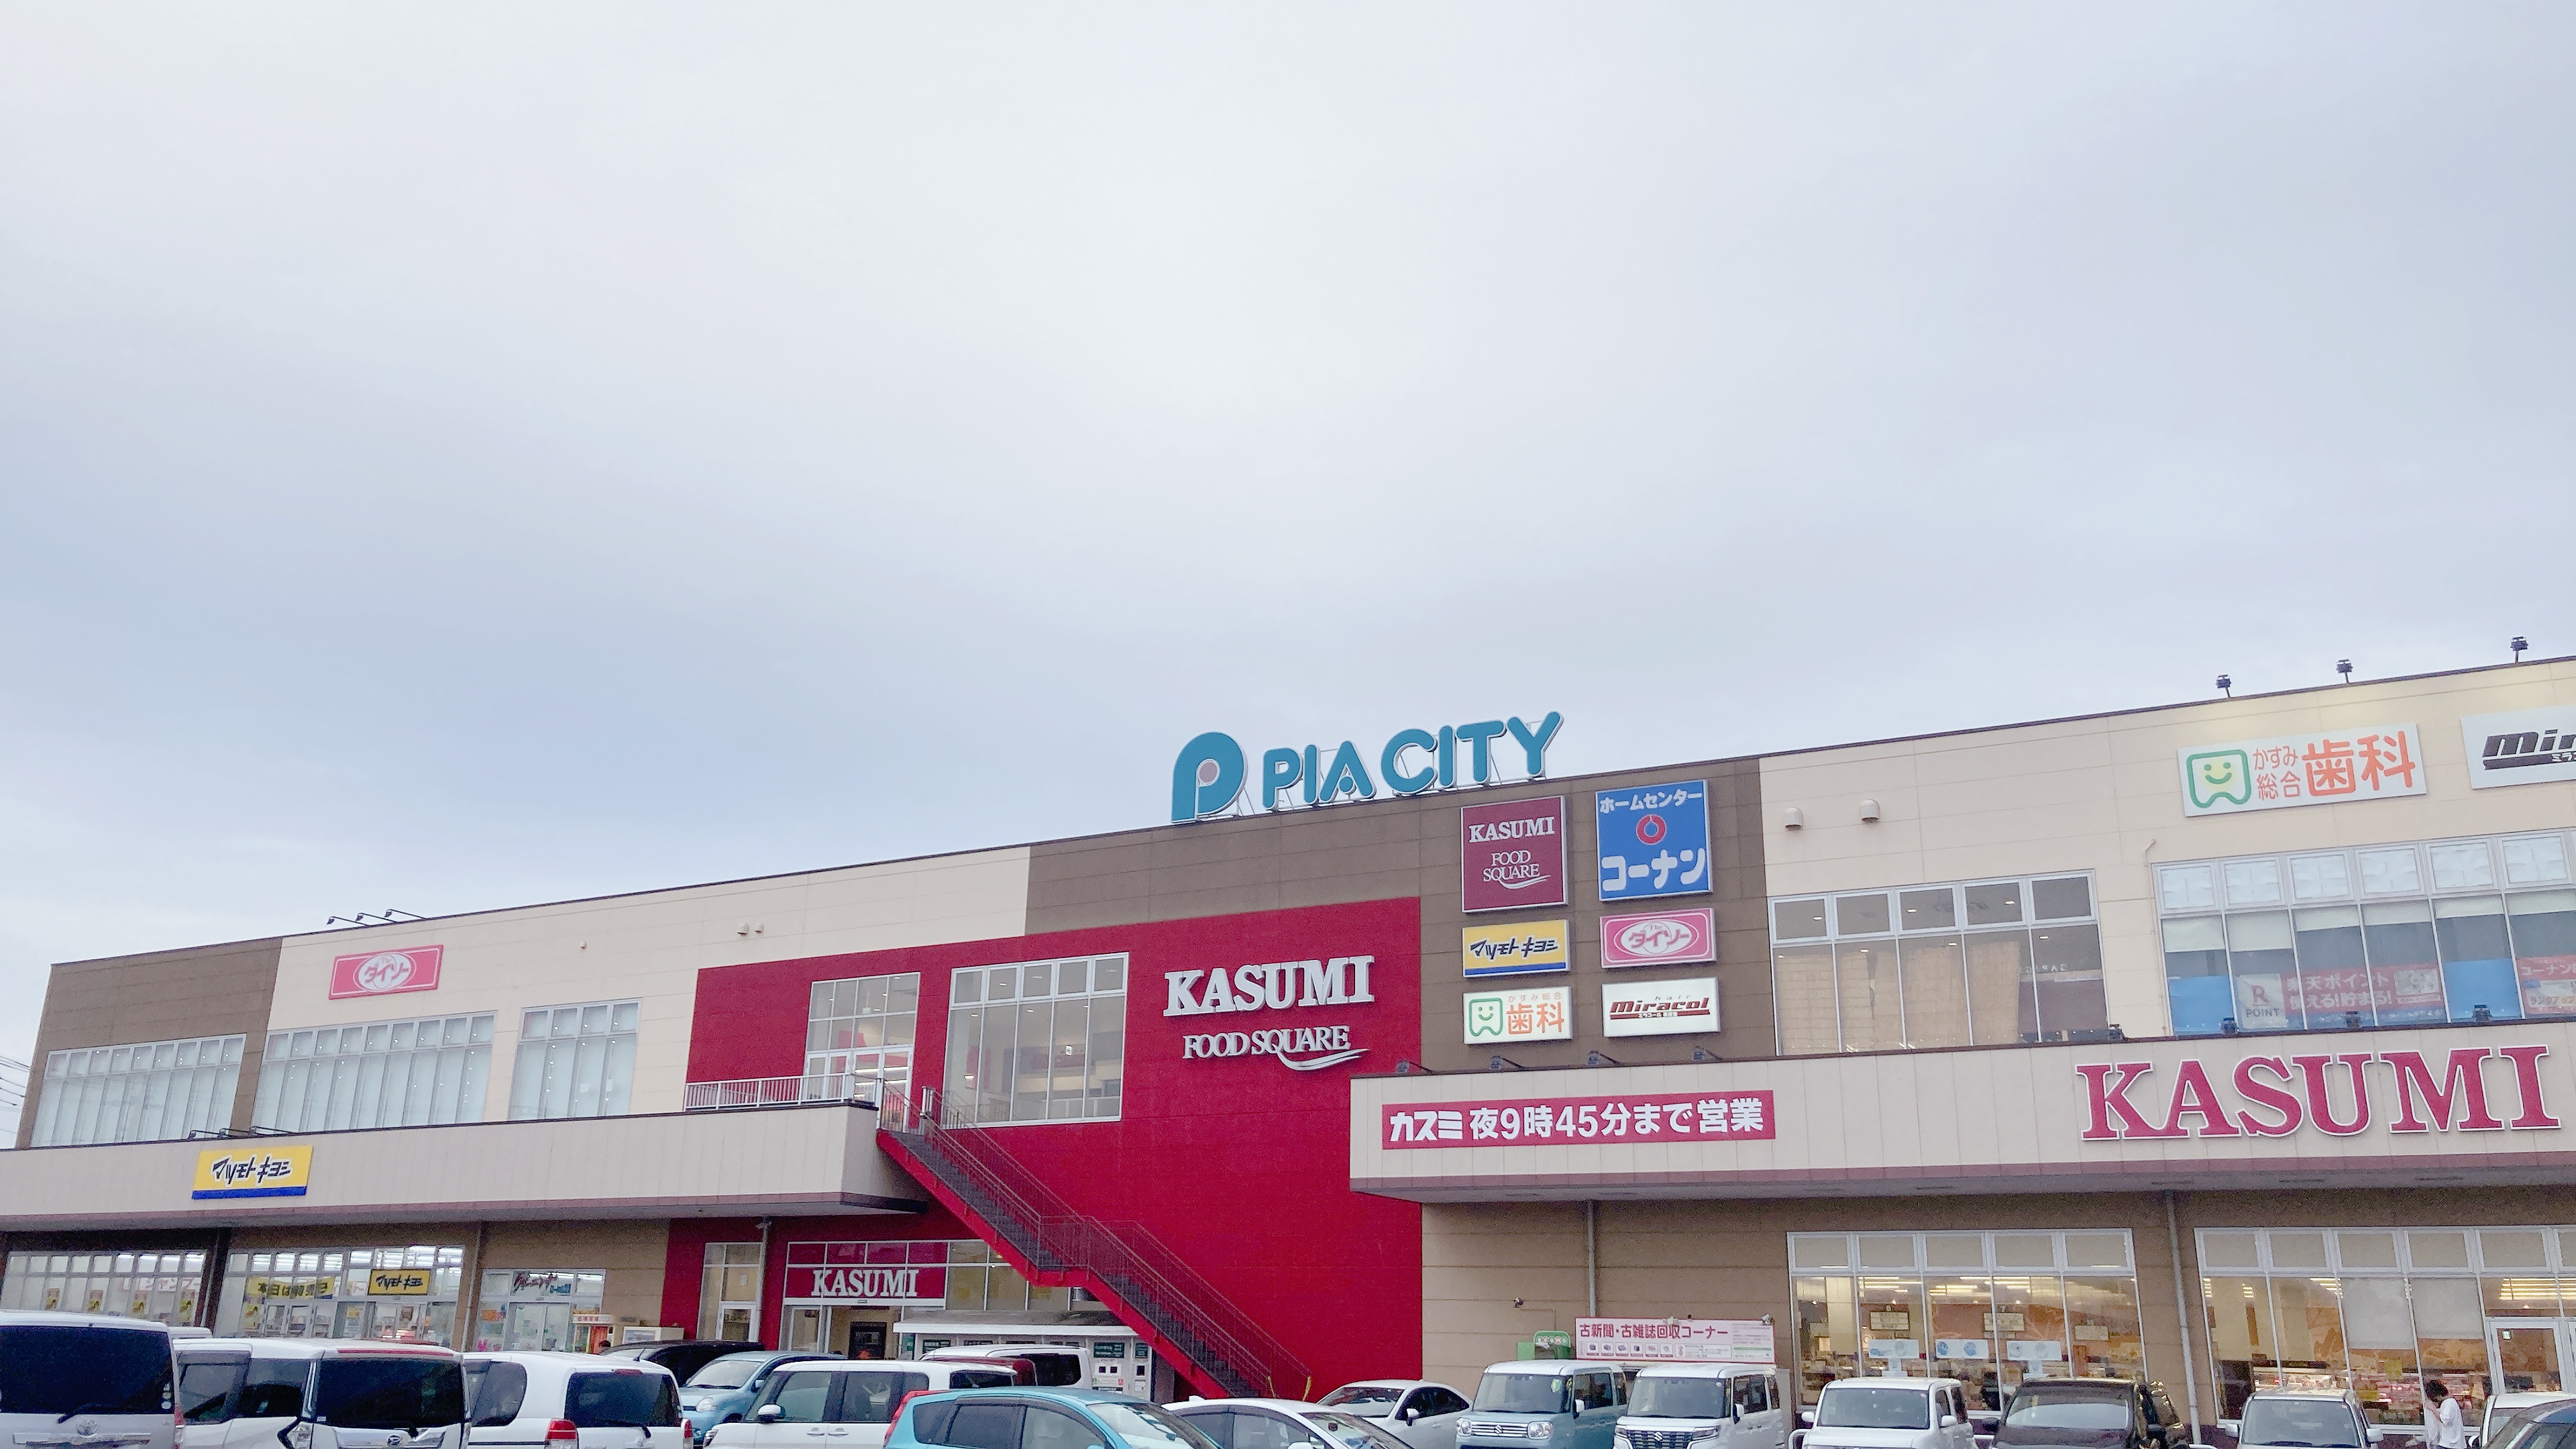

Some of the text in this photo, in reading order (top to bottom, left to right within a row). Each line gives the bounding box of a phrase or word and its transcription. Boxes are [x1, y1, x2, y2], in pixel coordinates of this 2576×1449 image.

[1263, 740, 1376, 810] PIA
[1381, 710, 1564, 796] CITY
[2252, 745, 2298, 770] かすみ
[2302, 731, 2416, 796] 歯科
[2256, 770, 2300, 800] 総合
[1600, 789, 1703, 814] ホームセンター
[1468, 816, 1555, 843] KASUMI
[1491, 850, 1532, 866] FOOD
[1601, 847, 1705, 892] コーナン
[1483, 863, 1550, 888] SQUARE
[1470, 936, 1558, 960] マツモトキヨシ
[1628, 928, 1690, 949] ダイソー
[364, 963, 410, 983] ダイソー
[1163, 955, 1375, 1016] KASUMI
[1507, 1002, 1564, 1034] 歯科
[2246, 1008, 2279, 1018] POINT
[1182, 1025, 1366, 1069] FOOD SQUARE
[2076, 1045, 2562, 1140] KASUMI
[1389, 1097, 1764, 1141] カスミ 夜9時45分まで営業
[213, 1156, 290, 1185] マツモトキヨシ
[811, 1268, 919, 1297] KASUMI
[1579, 1324, 1728, 1339] 古新聞・古雑誌回収コーナー
